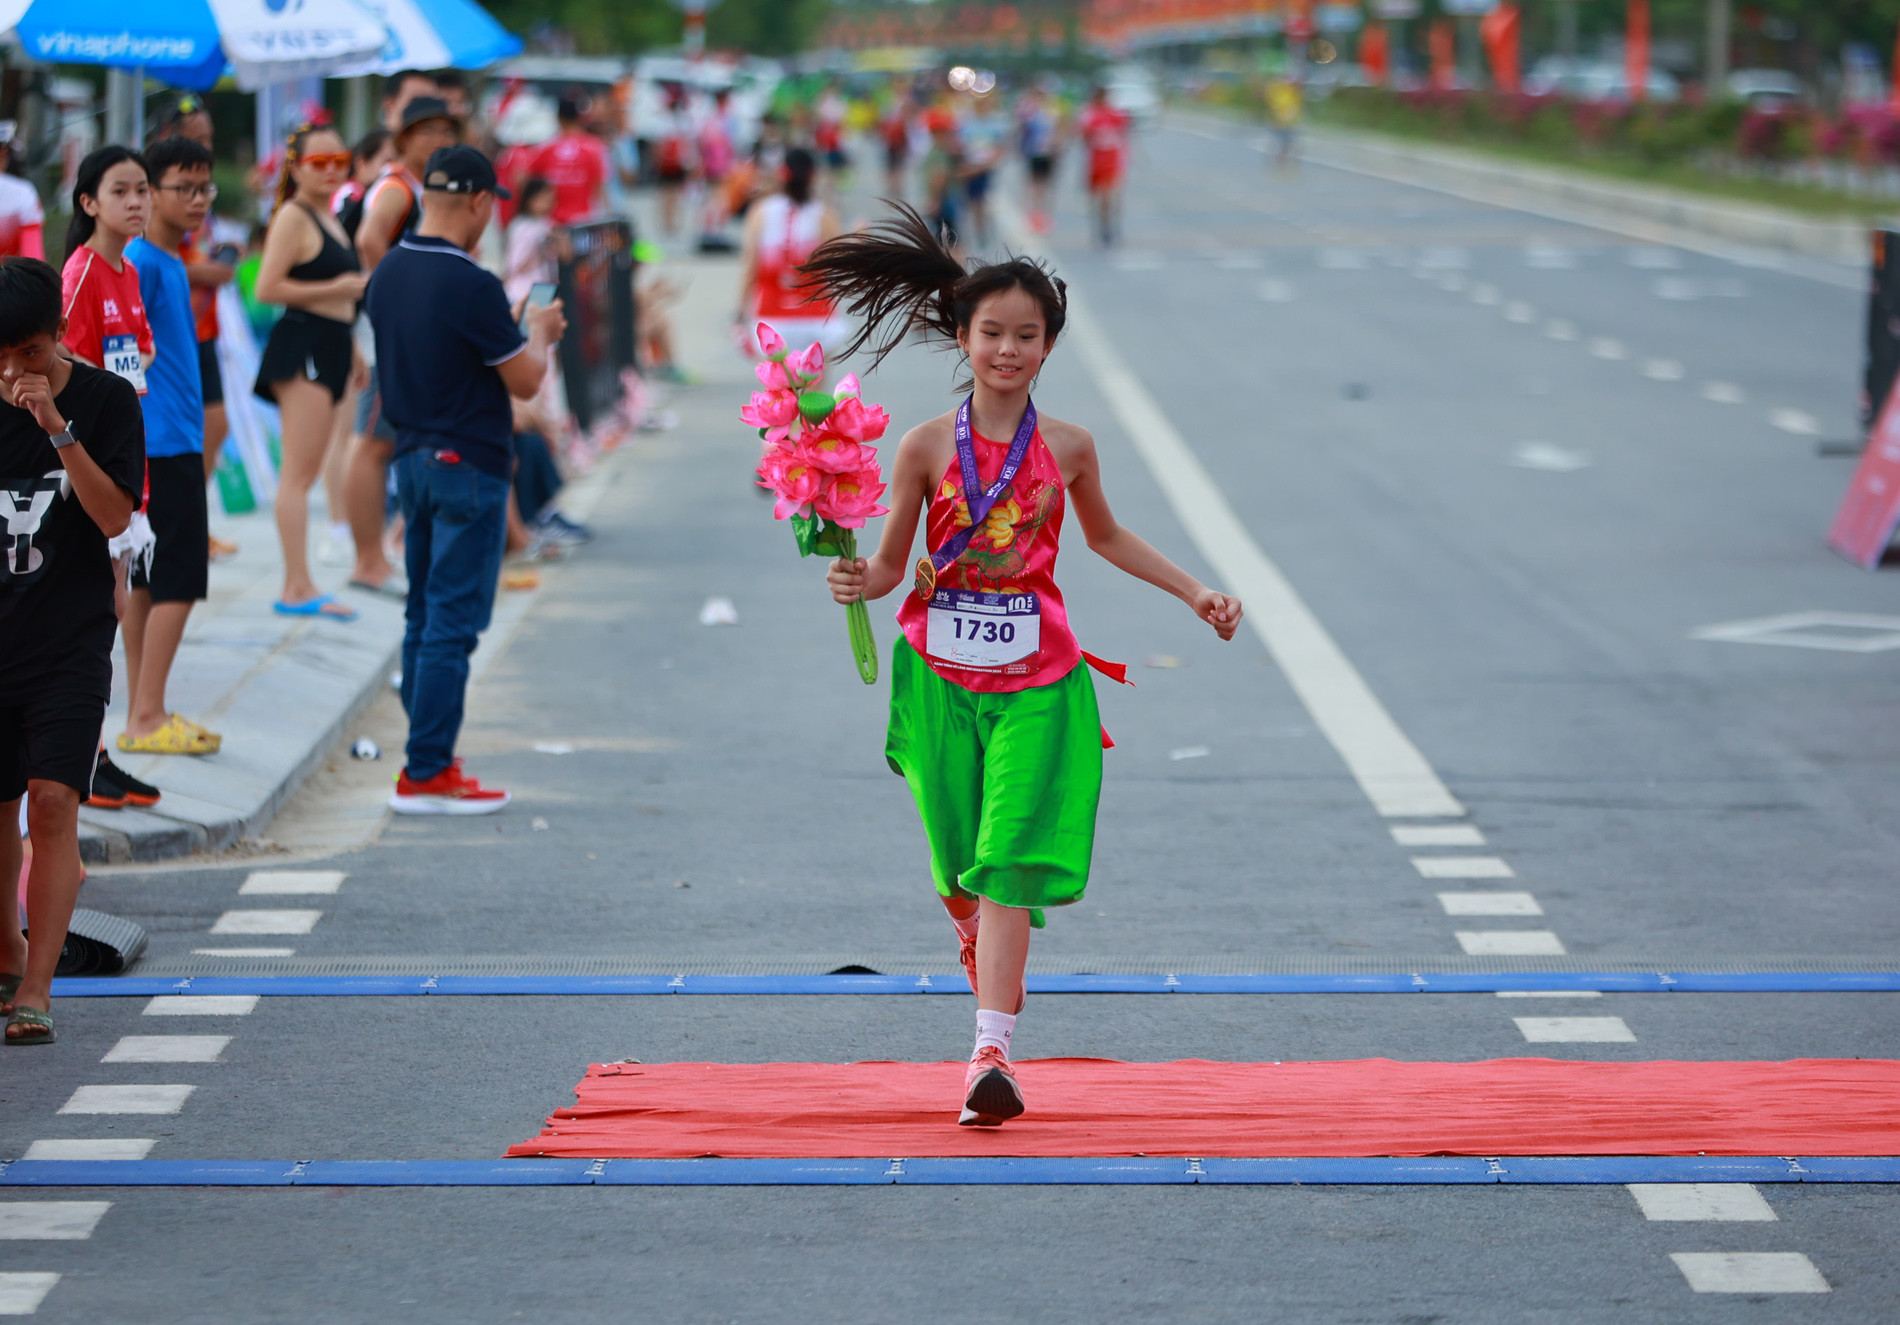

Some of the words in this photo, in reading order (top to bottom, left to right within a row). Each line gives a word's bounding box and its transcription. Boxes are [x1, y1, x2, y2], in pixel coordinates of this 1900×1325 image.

[1007, 597, 1026, 611] 10
[1027, 596, 1033, 609] KM
[953, 617, 1015, 643] 1730
